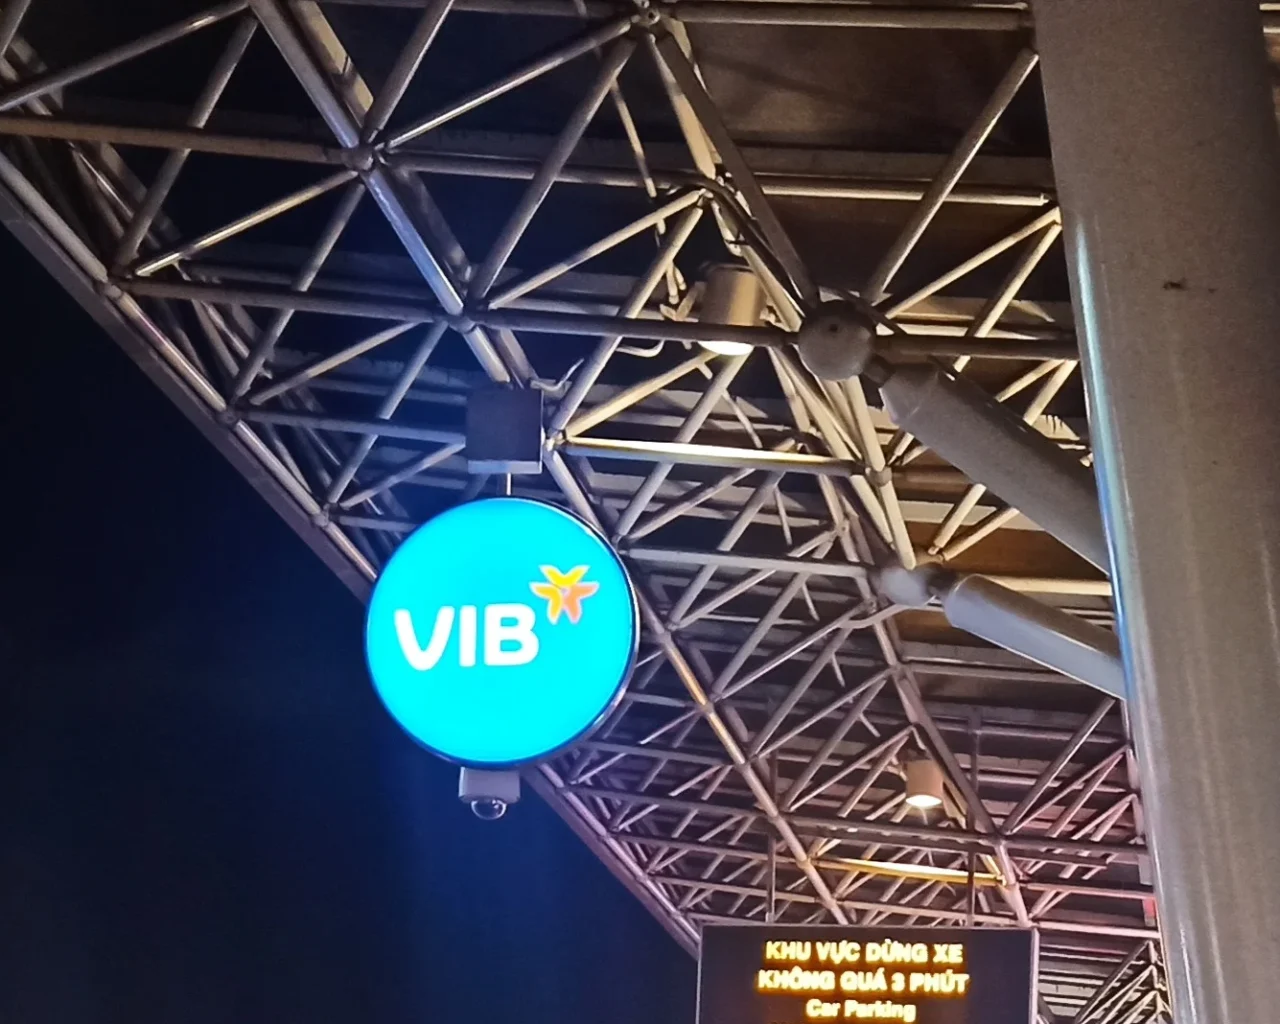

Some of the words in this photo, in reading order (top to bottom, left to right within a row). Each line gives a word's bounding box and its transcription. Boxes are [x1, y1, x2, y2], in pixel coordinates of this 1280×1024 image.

[394, 602, 539, 671] VIB
[766, 941, 811, 960] KHU
[816, 940, 861, 964] VỰC
[933, 944, 963, 963] XE
[758, 966, 835, 990] KHÔNG
[840, 968, 888, 991] QUÁ
[891, 973, 905, 991] 3
[909, 970, 969, 993] PHÚT
[806, 999, 840, 1017] Car
[844, 1000, 916, 1023] Parking
